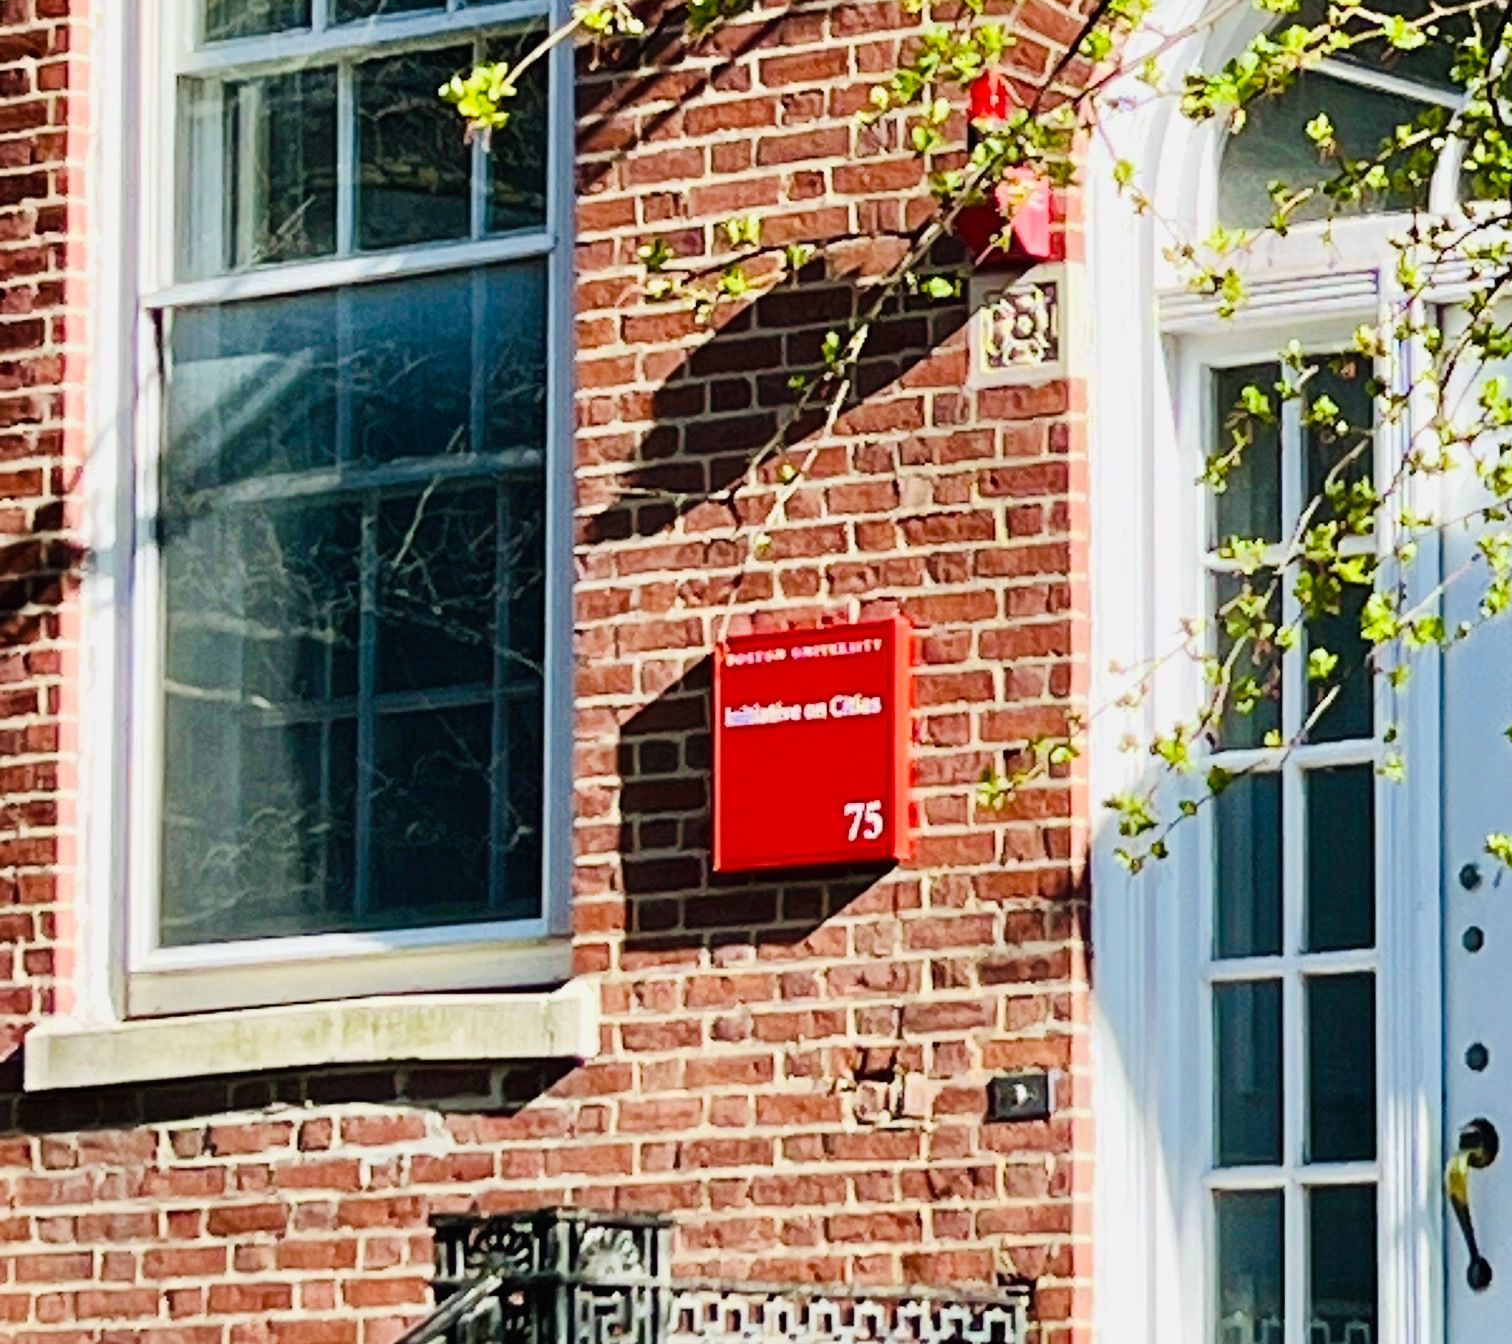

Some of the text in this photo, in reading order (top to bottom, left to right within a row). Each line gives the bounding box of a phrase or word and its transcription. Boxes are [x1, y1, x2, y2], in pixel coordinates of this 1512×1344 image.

[724, 692, 882, 728] Initiative on Cities
[843, 799, 884, 842] 75
